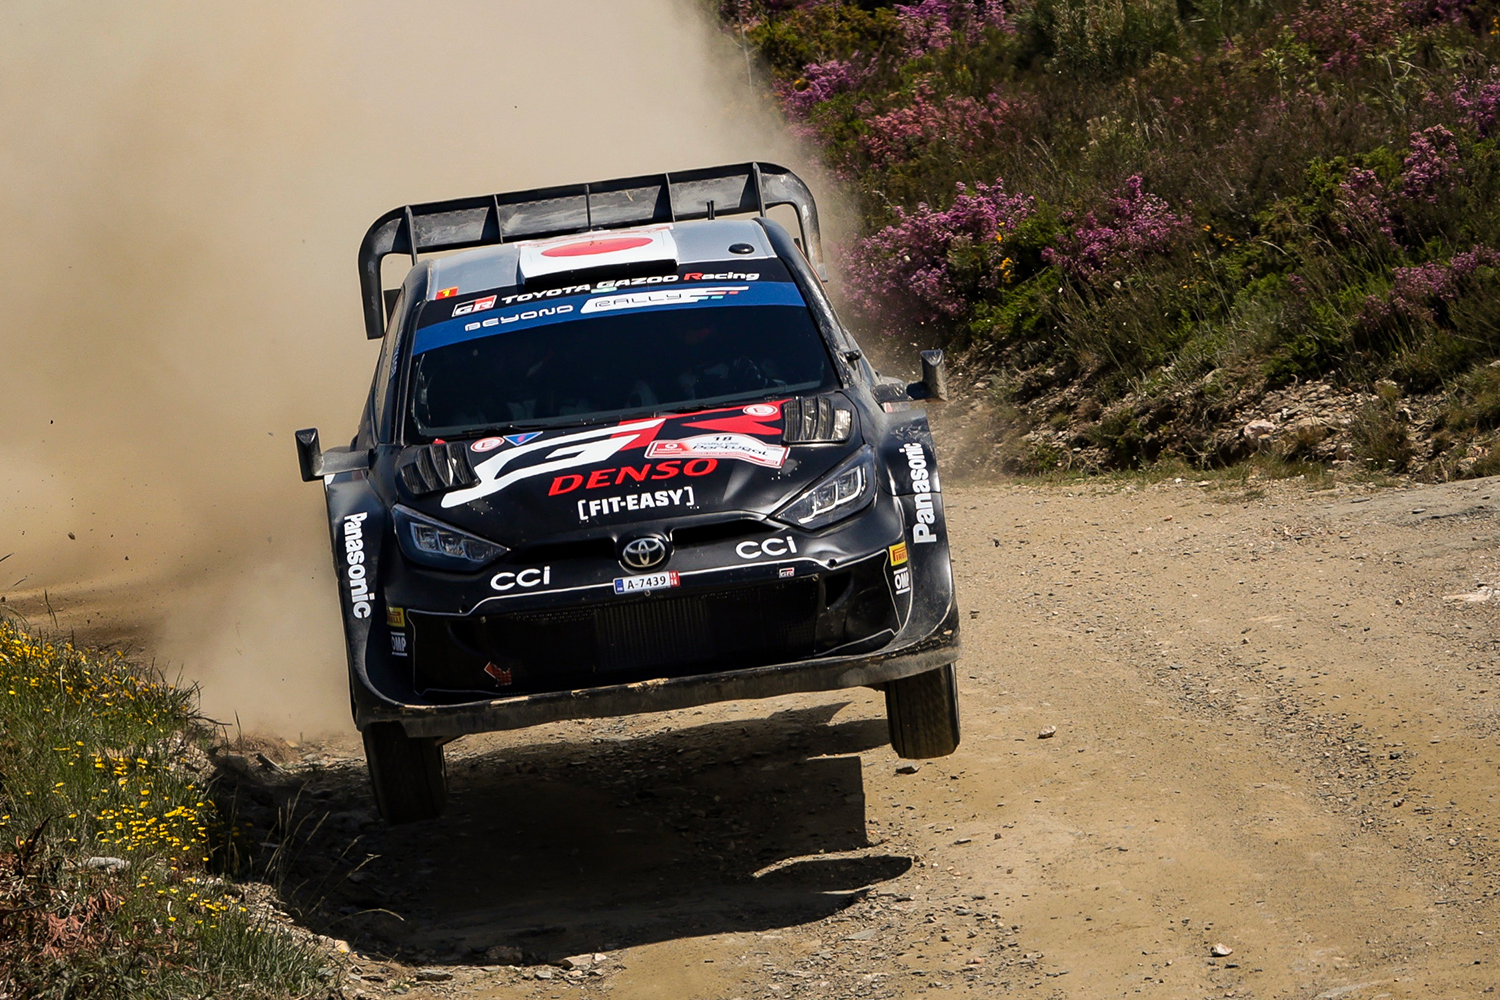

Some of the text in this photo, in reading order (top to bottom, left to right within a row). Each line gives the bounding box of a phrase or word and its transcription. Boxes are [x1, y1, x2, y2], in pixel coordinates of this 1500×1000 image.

[454, 299, 494, 315] GR
[501, 271, 760, 304] TOYOTA GAZOO Racing
[464, 293, 682, 332] BEYOND RALLY
[548, 458, 718, 497] DENSO
[898, 442, 937, 544] Panasonic
[343, 511, 375, 619] Panasonic
[627, 575, 666, 590] A-7439
